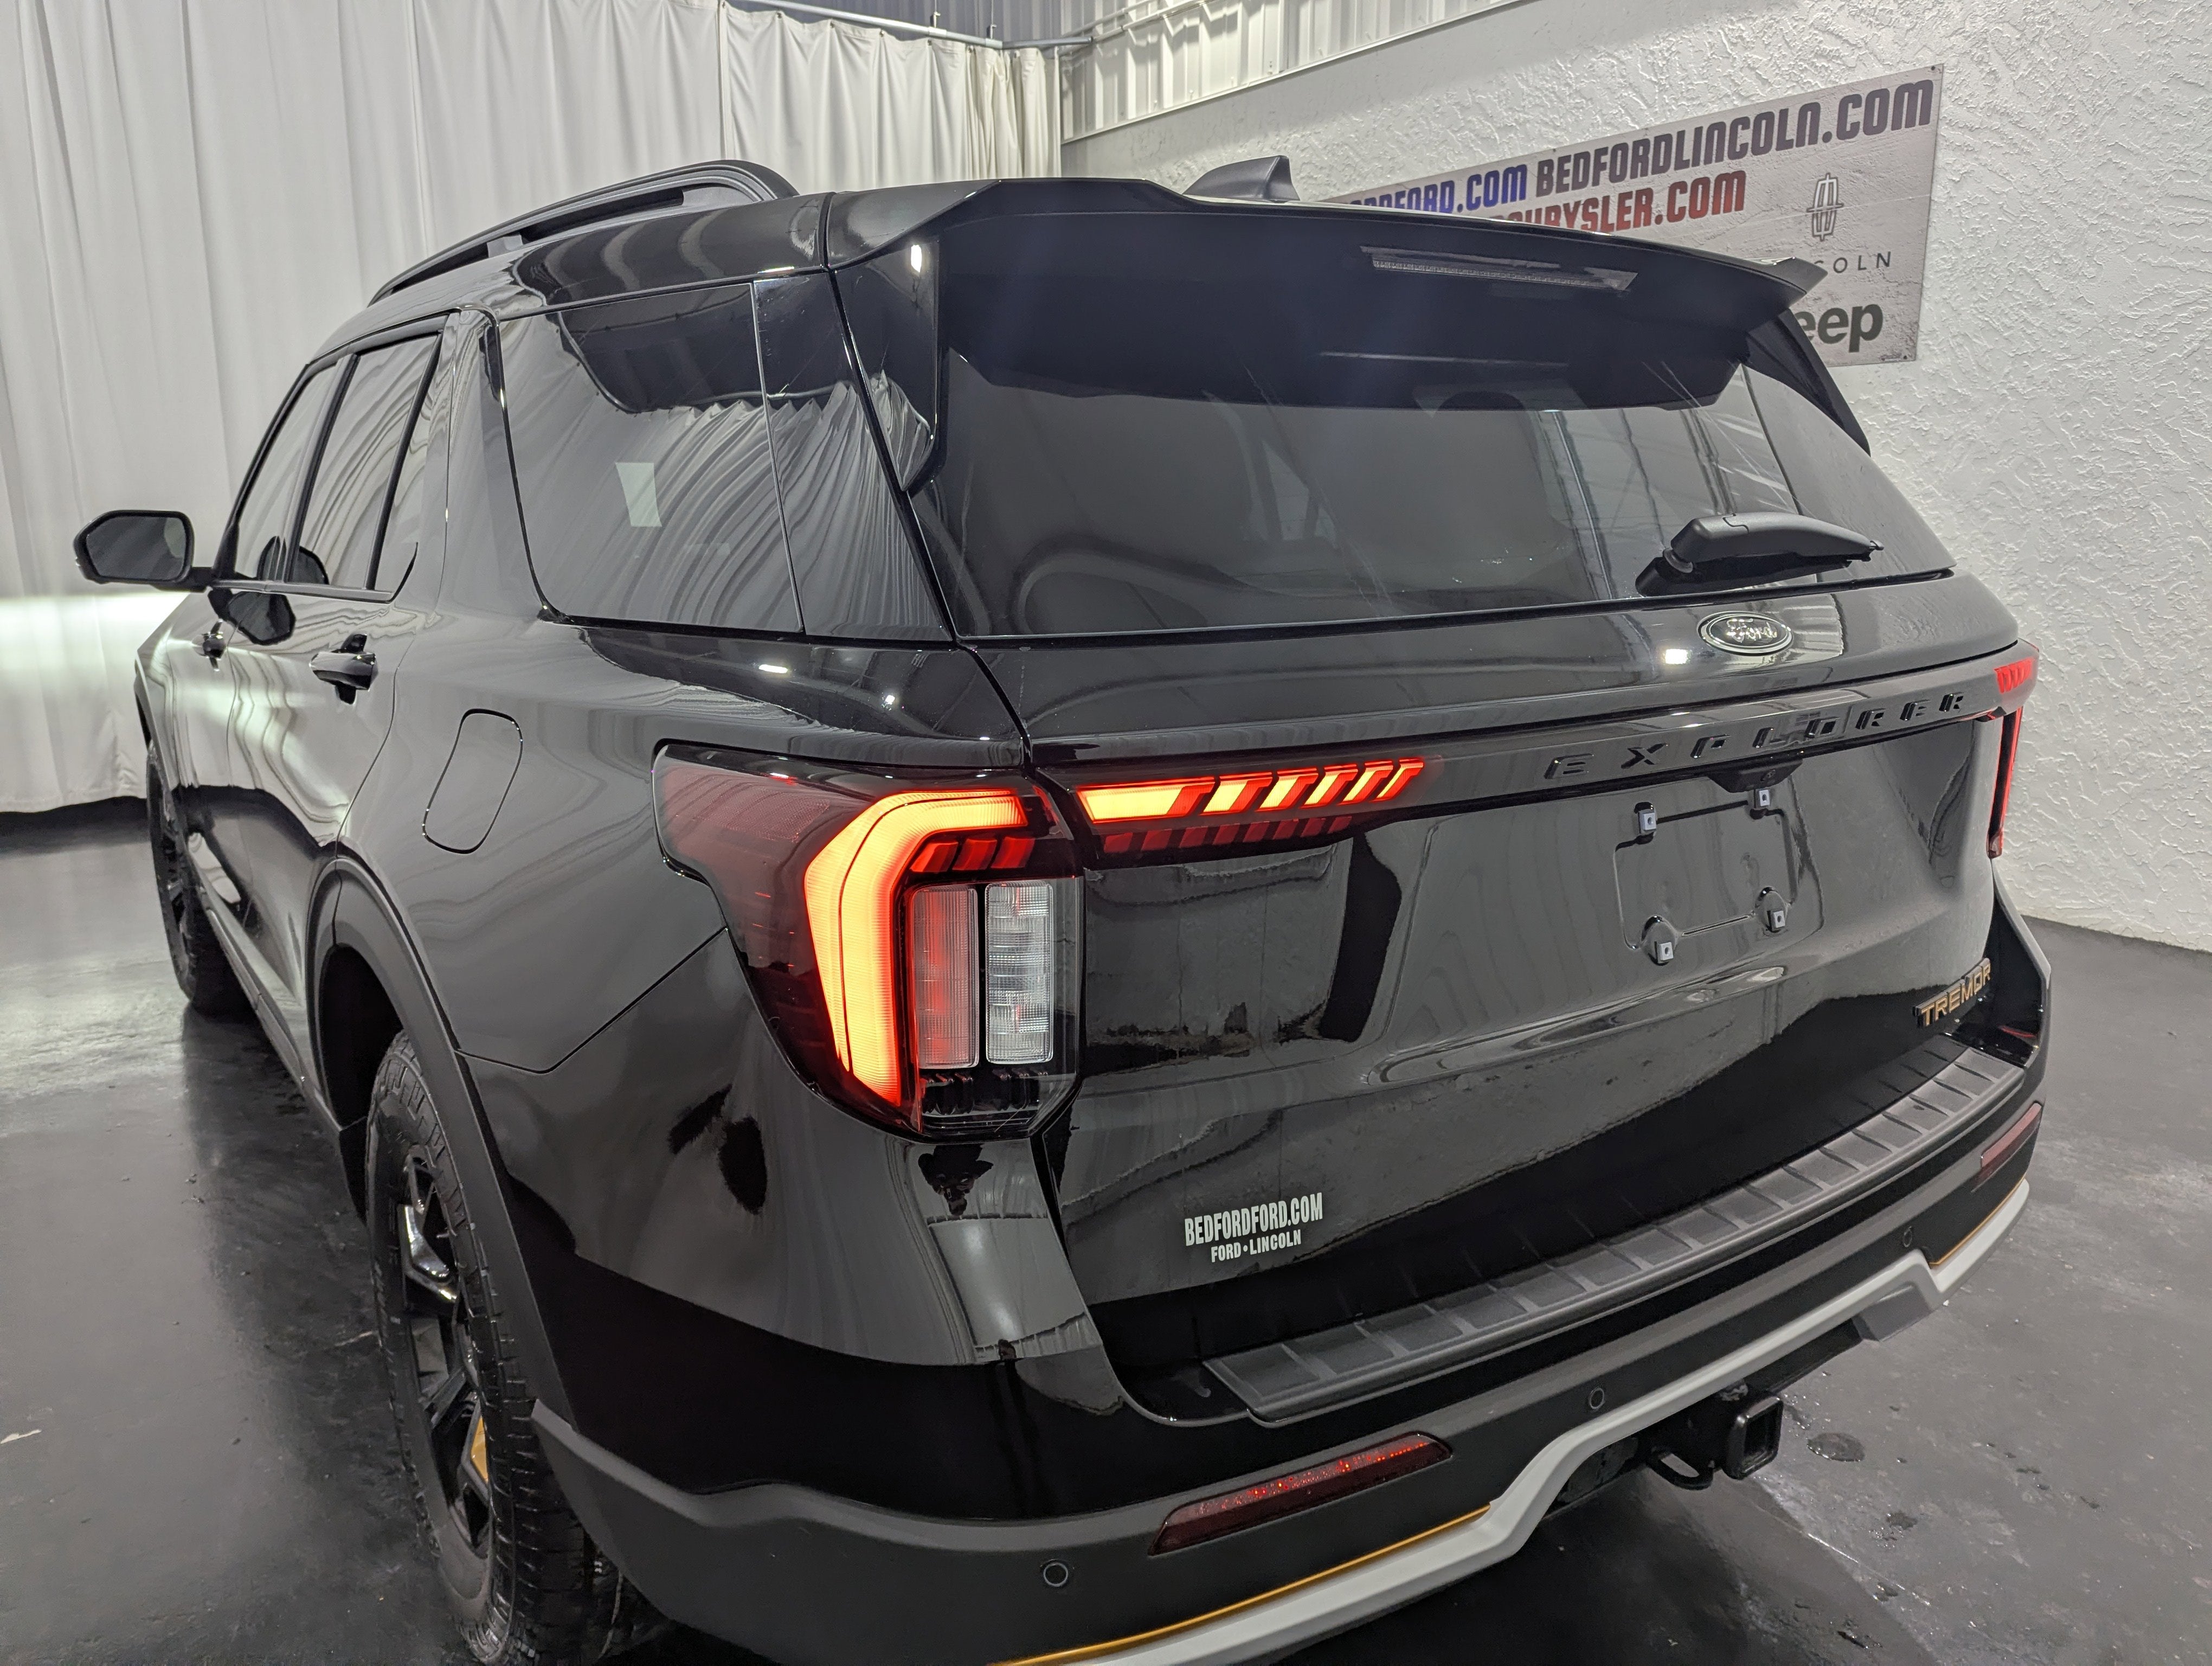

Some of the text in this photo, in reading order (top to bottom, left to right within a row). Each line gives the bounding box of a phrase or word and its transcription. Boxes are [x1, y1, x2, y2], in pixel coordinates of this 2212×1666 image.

[1349, 79, 1934, 213] FORD.COM BEDFORDLINCOLN.COM
[1490, 170, 1746, 233] RYSLER.COM
[1814, 251, 1891, 273] OLN
[1794, 304, 1883, 353] eep
[1725, 618, 1778, 643] Ford
[1544, 691, 1964, 780] EXPLORER
[1920, 961, 1991, 1027] TREMOR
[1185, 1192, 1323, 1246] BEDFORDFORD.COM
